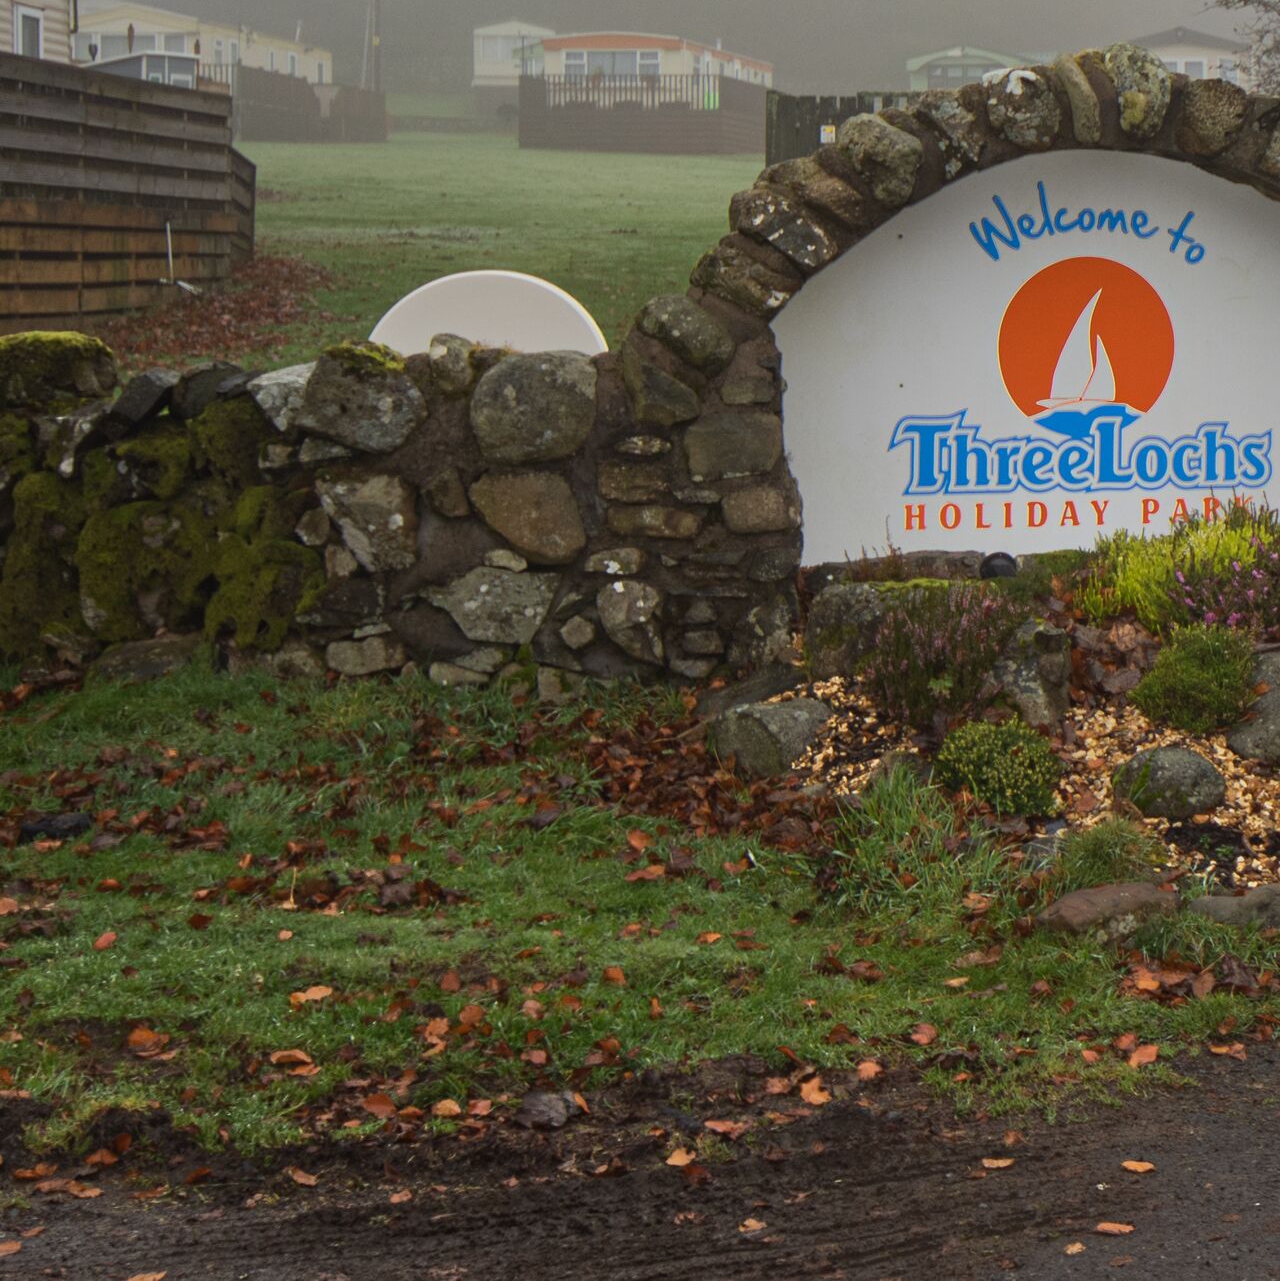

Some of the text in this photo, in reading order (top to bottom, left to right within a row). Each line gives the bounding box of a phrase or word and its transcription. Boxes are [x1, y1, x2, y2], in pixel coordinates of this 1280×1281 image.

[969, 180, 1206, 265] Welcome to
[904, 500, 1109, 530] HOLIDAY
